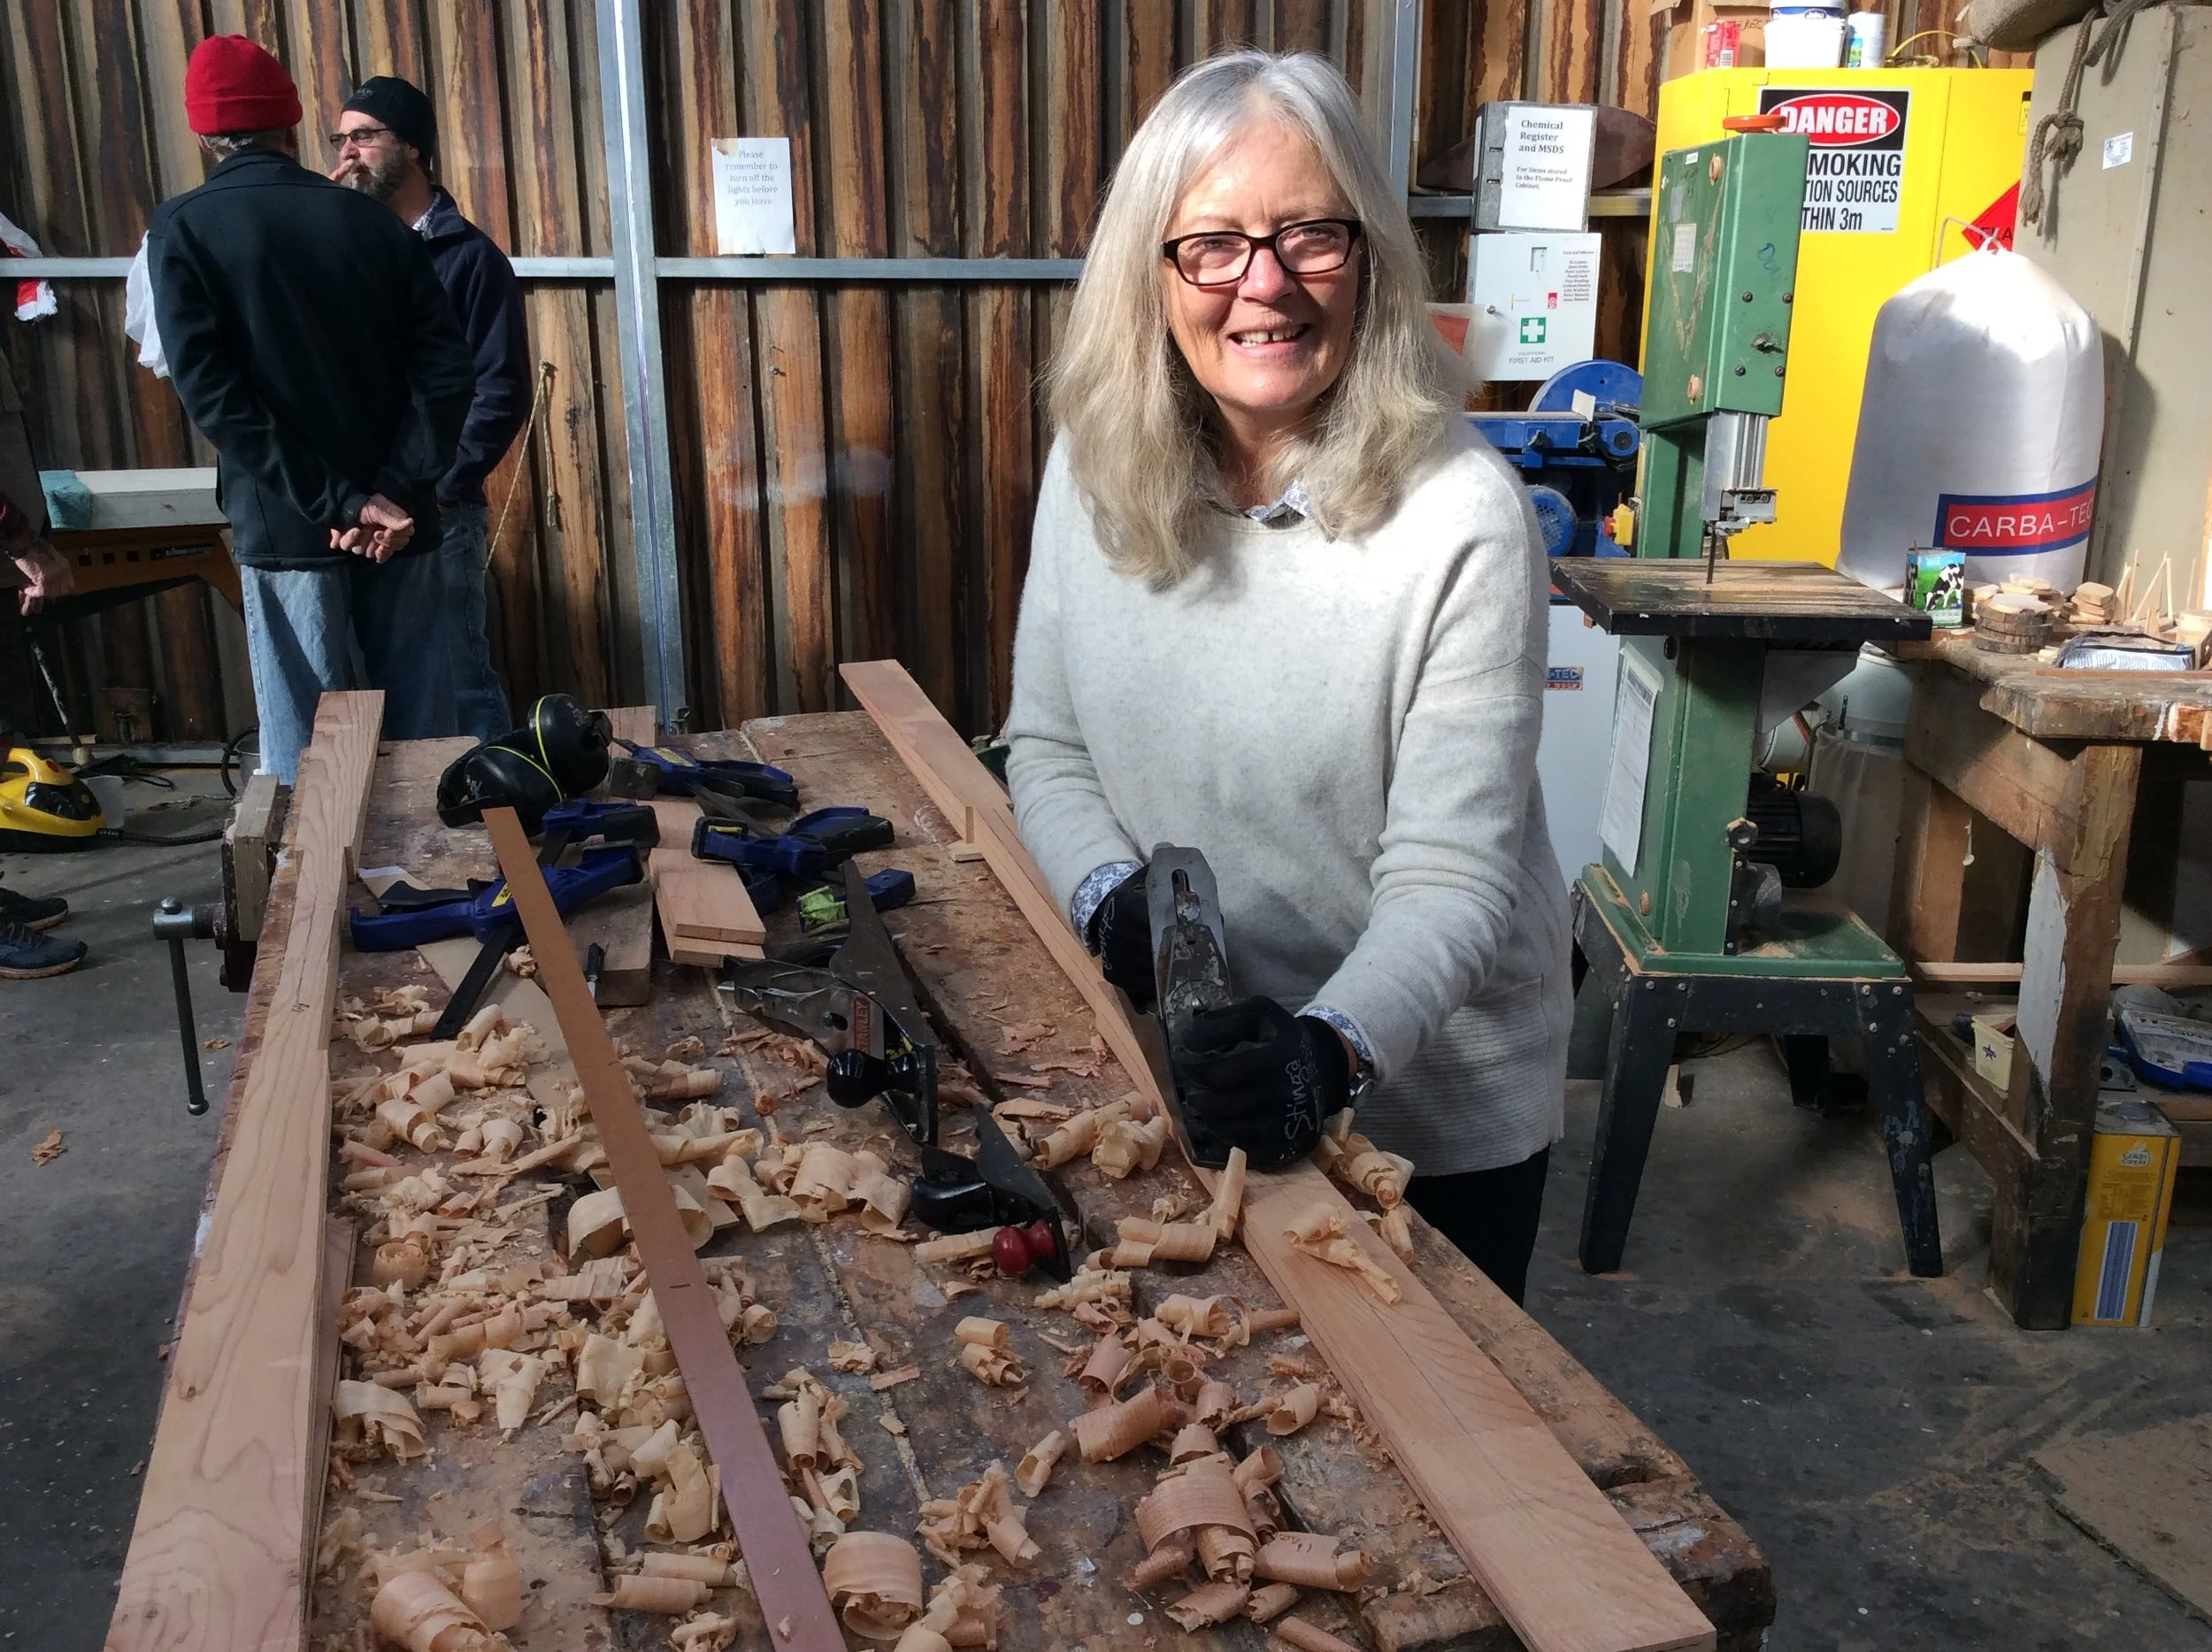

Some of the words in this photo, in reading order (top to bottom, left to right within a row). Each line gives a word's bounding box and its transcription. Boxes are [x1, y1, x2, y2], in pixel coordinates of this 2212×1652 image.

[1521, 120, 1563, 129] Chemical
[1778, 106, 1888, 134] DANGER
[1520, 132, 1559, 142] Register
[738, 150, 764, 158] Please
[1539, 144, 1564, 154] MSDS
[1808, 153, 1901, 176] MOKING
[728, 186, 750, 195] lights
[751, 185, 778, 194] before
[1836, 180, 1898, 203] SOURCES
[734, 197, 750, 207] you
[1801, 207, 1836, 230] THIN
[1839, 207, 1863, 230] 3m
